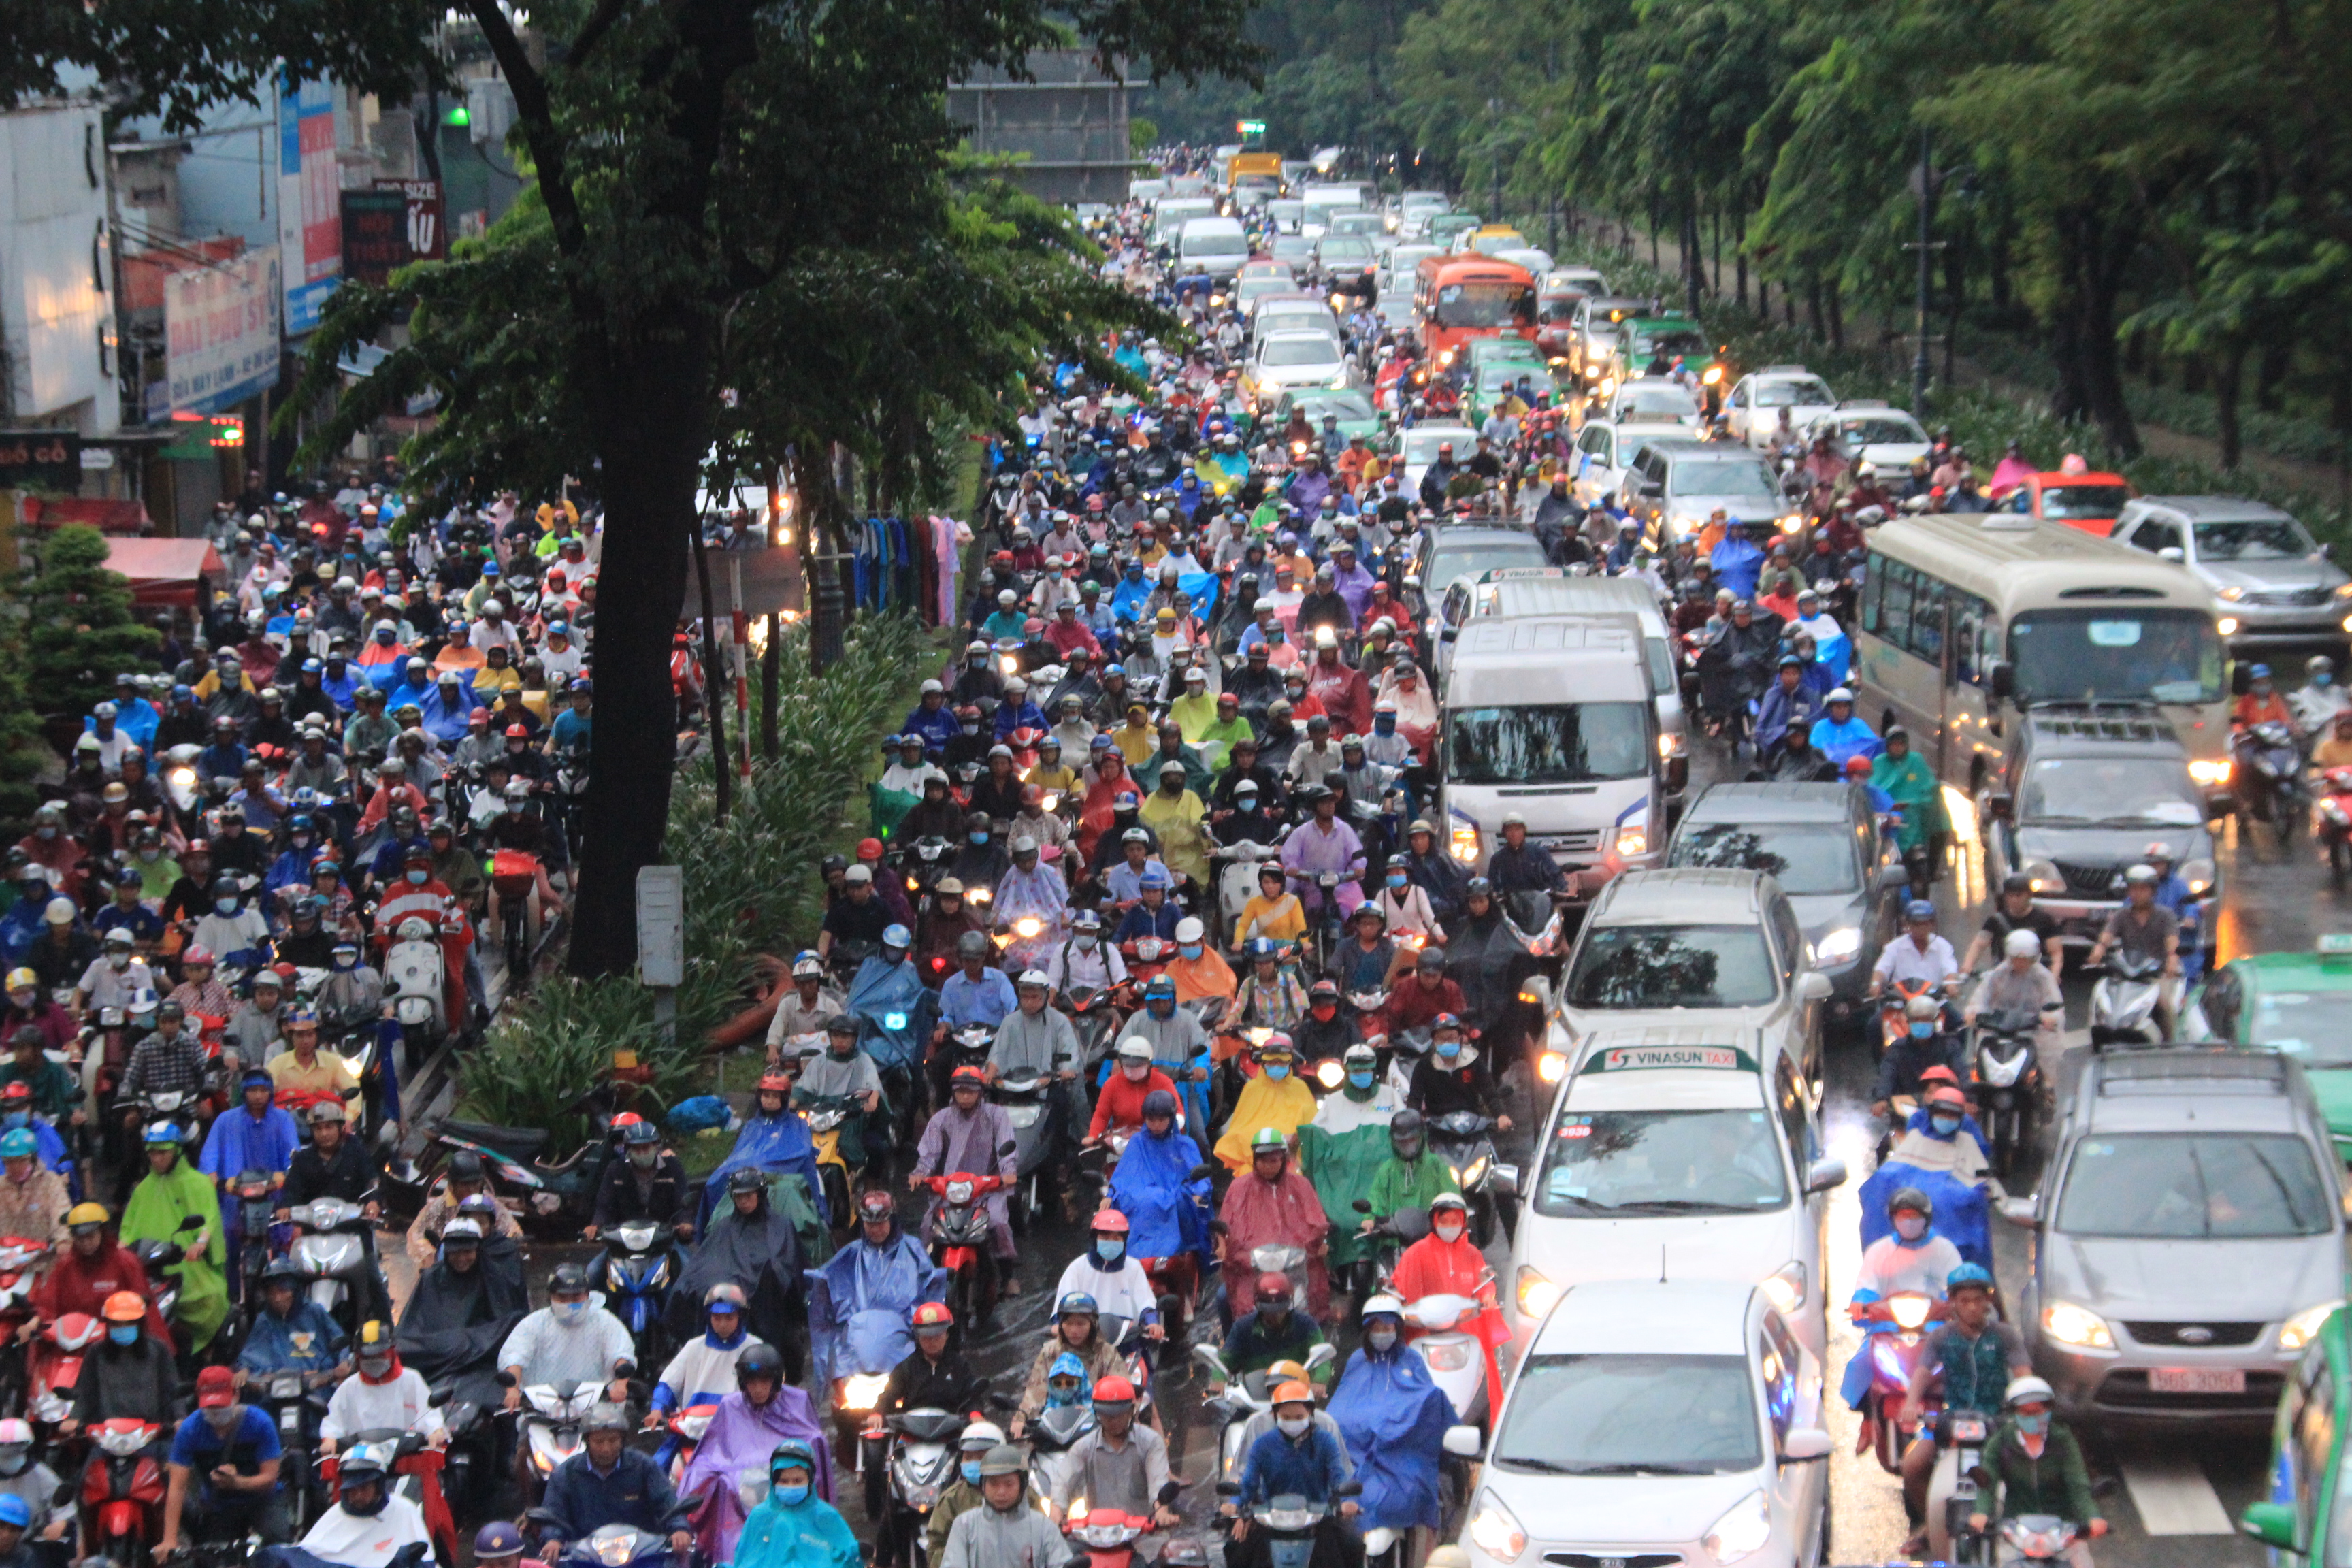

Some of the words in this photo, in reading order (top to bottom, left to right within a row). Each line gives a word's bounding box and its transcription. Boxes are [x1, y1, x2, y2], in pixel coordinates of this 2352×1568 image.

[404, 182, 436, 200] SIZE
[1637, 1051, 1702, 1064] VINASUN
[1705, 1051, 1735, 1064] TAXI
